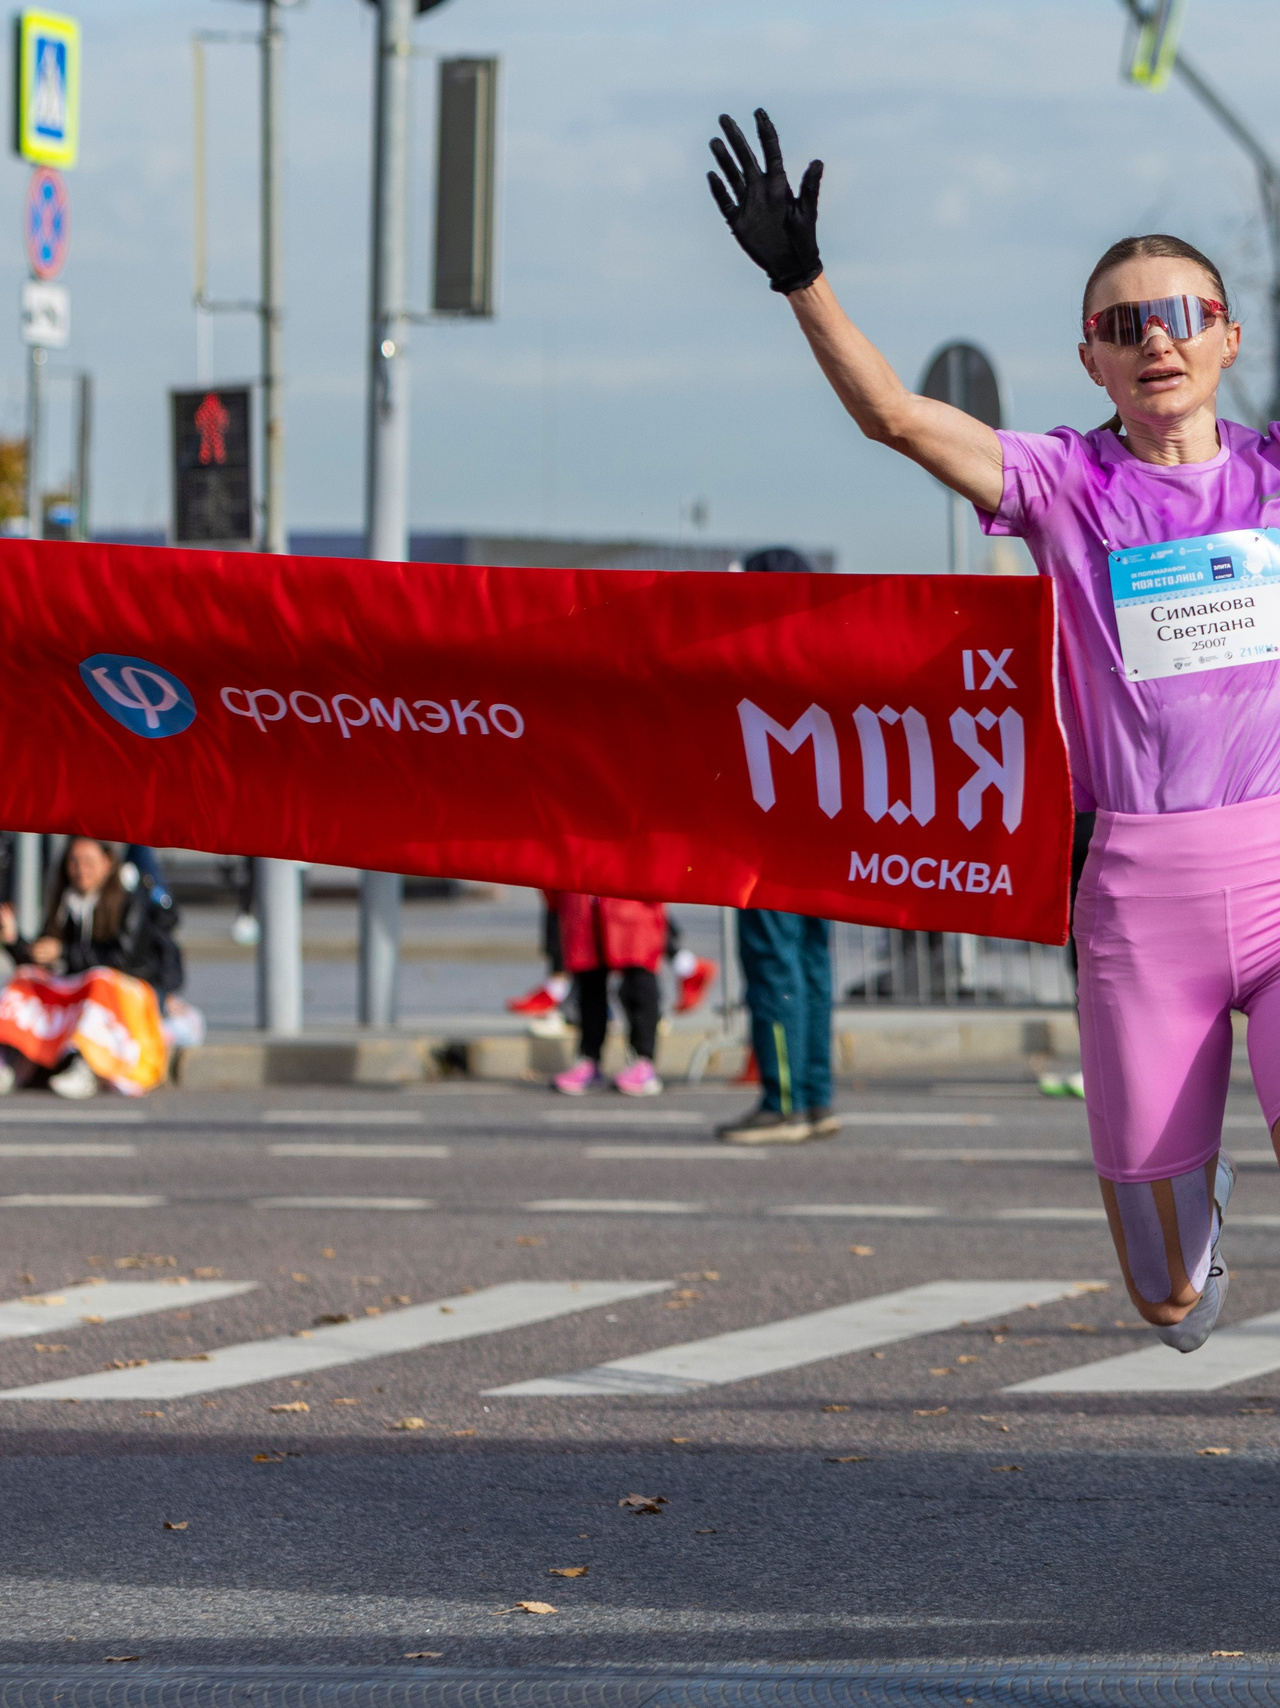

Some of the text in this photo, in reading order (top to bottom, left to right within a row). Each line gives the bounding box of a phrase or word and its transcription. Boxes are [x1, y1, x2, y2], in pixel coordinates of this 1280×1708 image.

[1213, 563, 1232, 571] ЭЛИТА
[1131, 571, 1204, 591] МОЯ СТОЛИЦА
[1150, 596, 1256, 623] Симакова
[1156, 616, 1256, 642] Светлана
[1191, 637, 1227, 651] 25007
[962, 648, 1018, 691] IX
[220, 686, 525, 739] фармэко
[737, 698, 1025, 834] МОЯ
[848, 851, 1013, 896] МОСКВА
